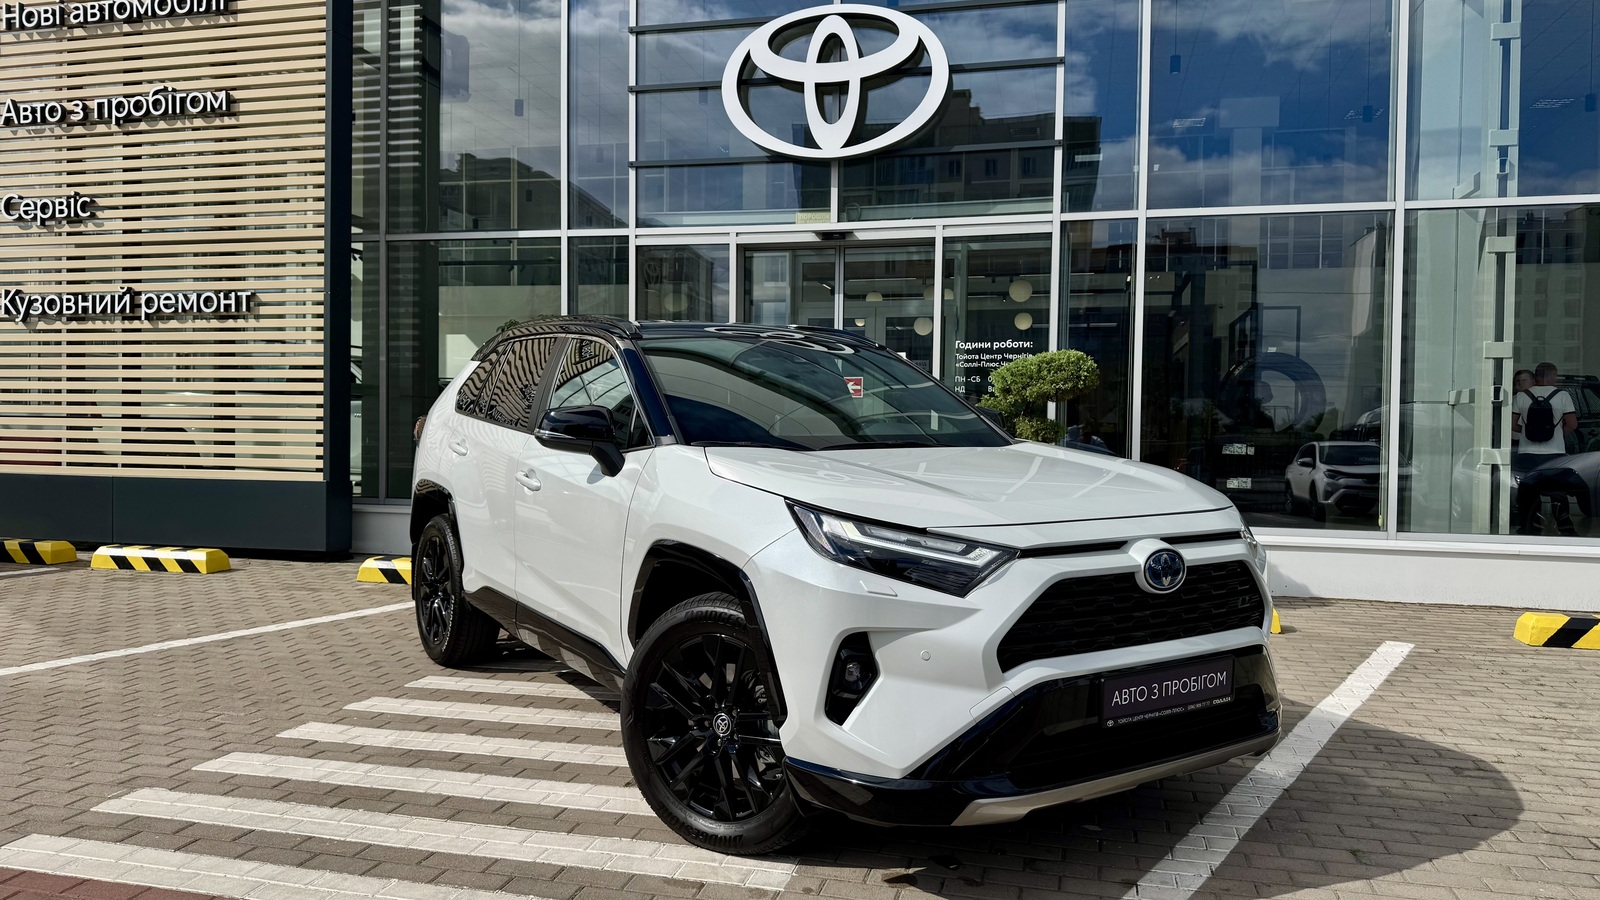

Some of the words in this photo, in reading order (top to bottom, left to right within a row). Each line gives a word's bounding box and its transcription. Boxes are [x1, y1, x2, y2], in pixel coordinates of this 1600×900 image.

[3, 0, 60, 29] Нові
[1, 98, 62, 125] Авто
[70, 100, 85, 121] з
[94, 85, 228, 125] пробігом
[1, 190, 92, 226] Сервіс
[1, 286, 131, 322] Кузовний
[141, 291, 252, 320] ремонт
[955, 340, 991, 350] Години
[993, 339, 1034, 350] роботи:
[955, 353, 979, 361] Тойота
[980, 353, 1003, 361] Центр
[954, 385, 966, 393] НД
[955, 375, 966, 383] ПН
[684, 609, 746, 630] BRIDGES
[1111, 686, 1148, 707] АВТО
[1162, 671, 1227, 697] ПРОБІГОМ
